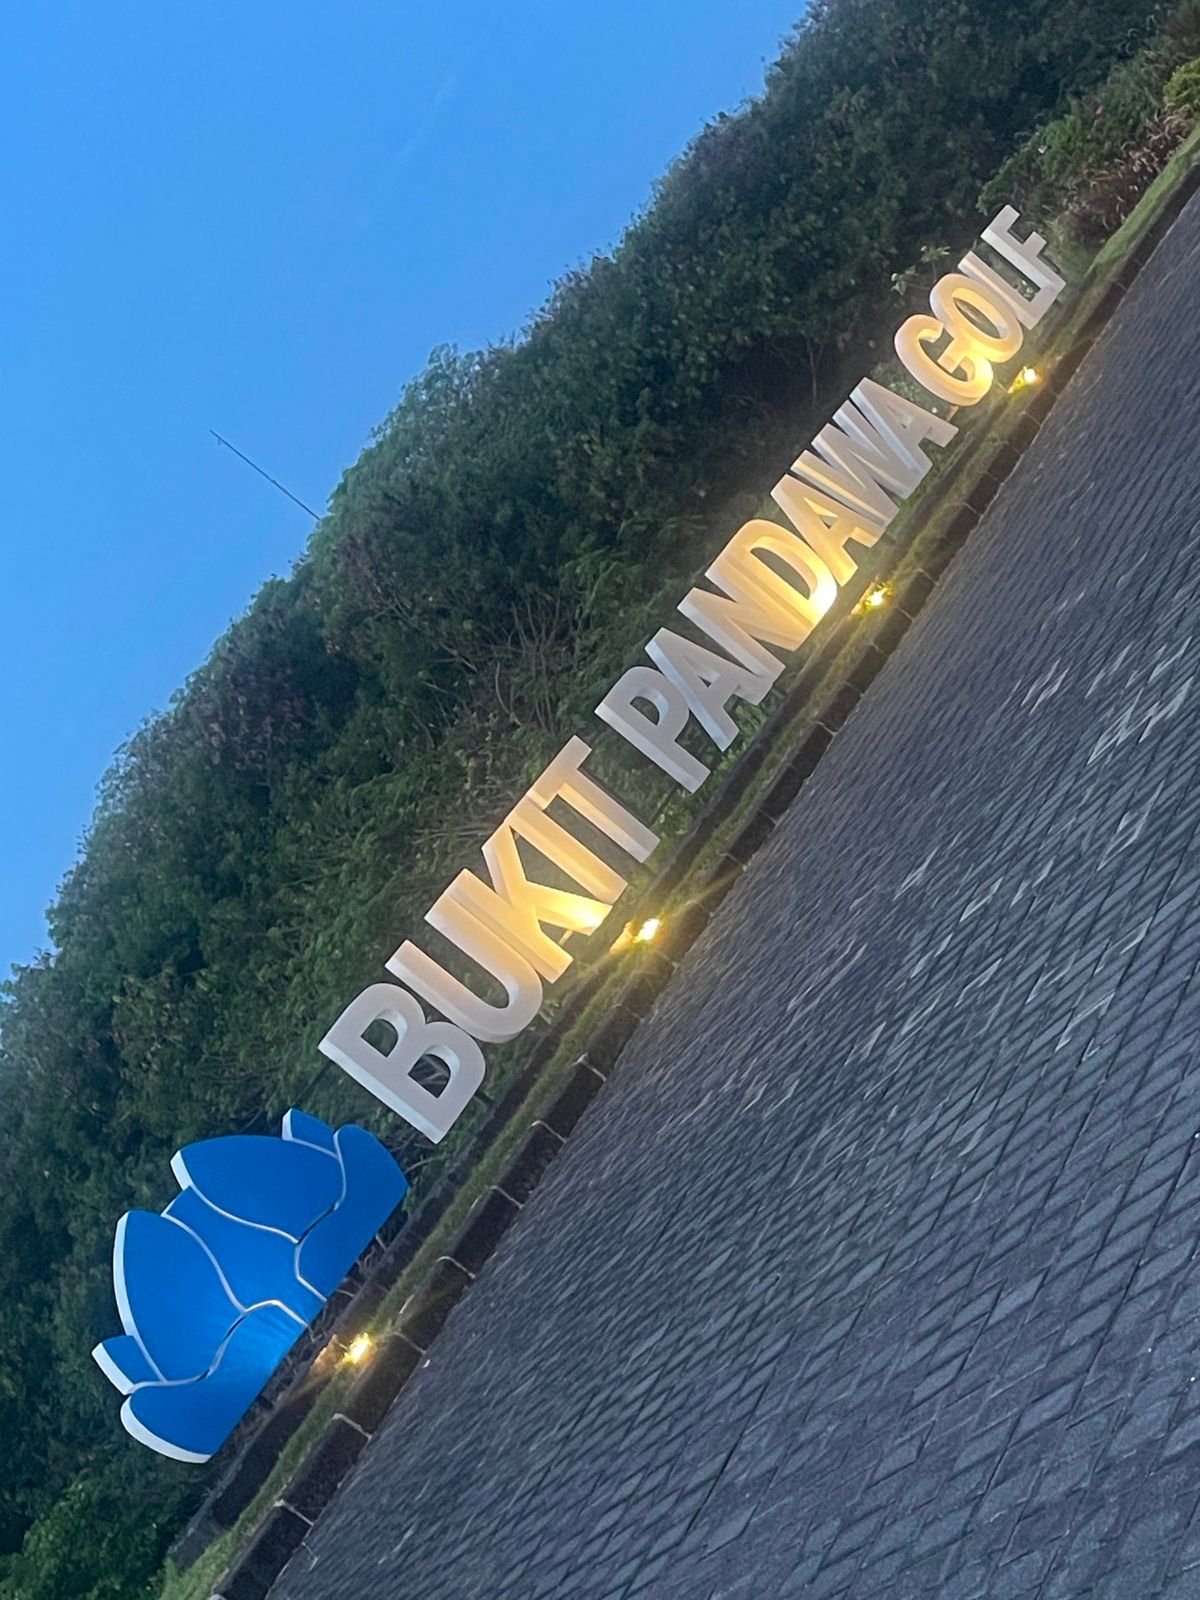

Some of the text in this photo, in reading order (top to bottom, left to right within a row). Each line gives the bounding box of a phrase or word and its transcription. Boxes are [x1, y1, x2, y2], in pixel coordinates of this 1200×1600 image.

[319, 204, 1067, 1144] BUKIT PANDAWA GOLF
